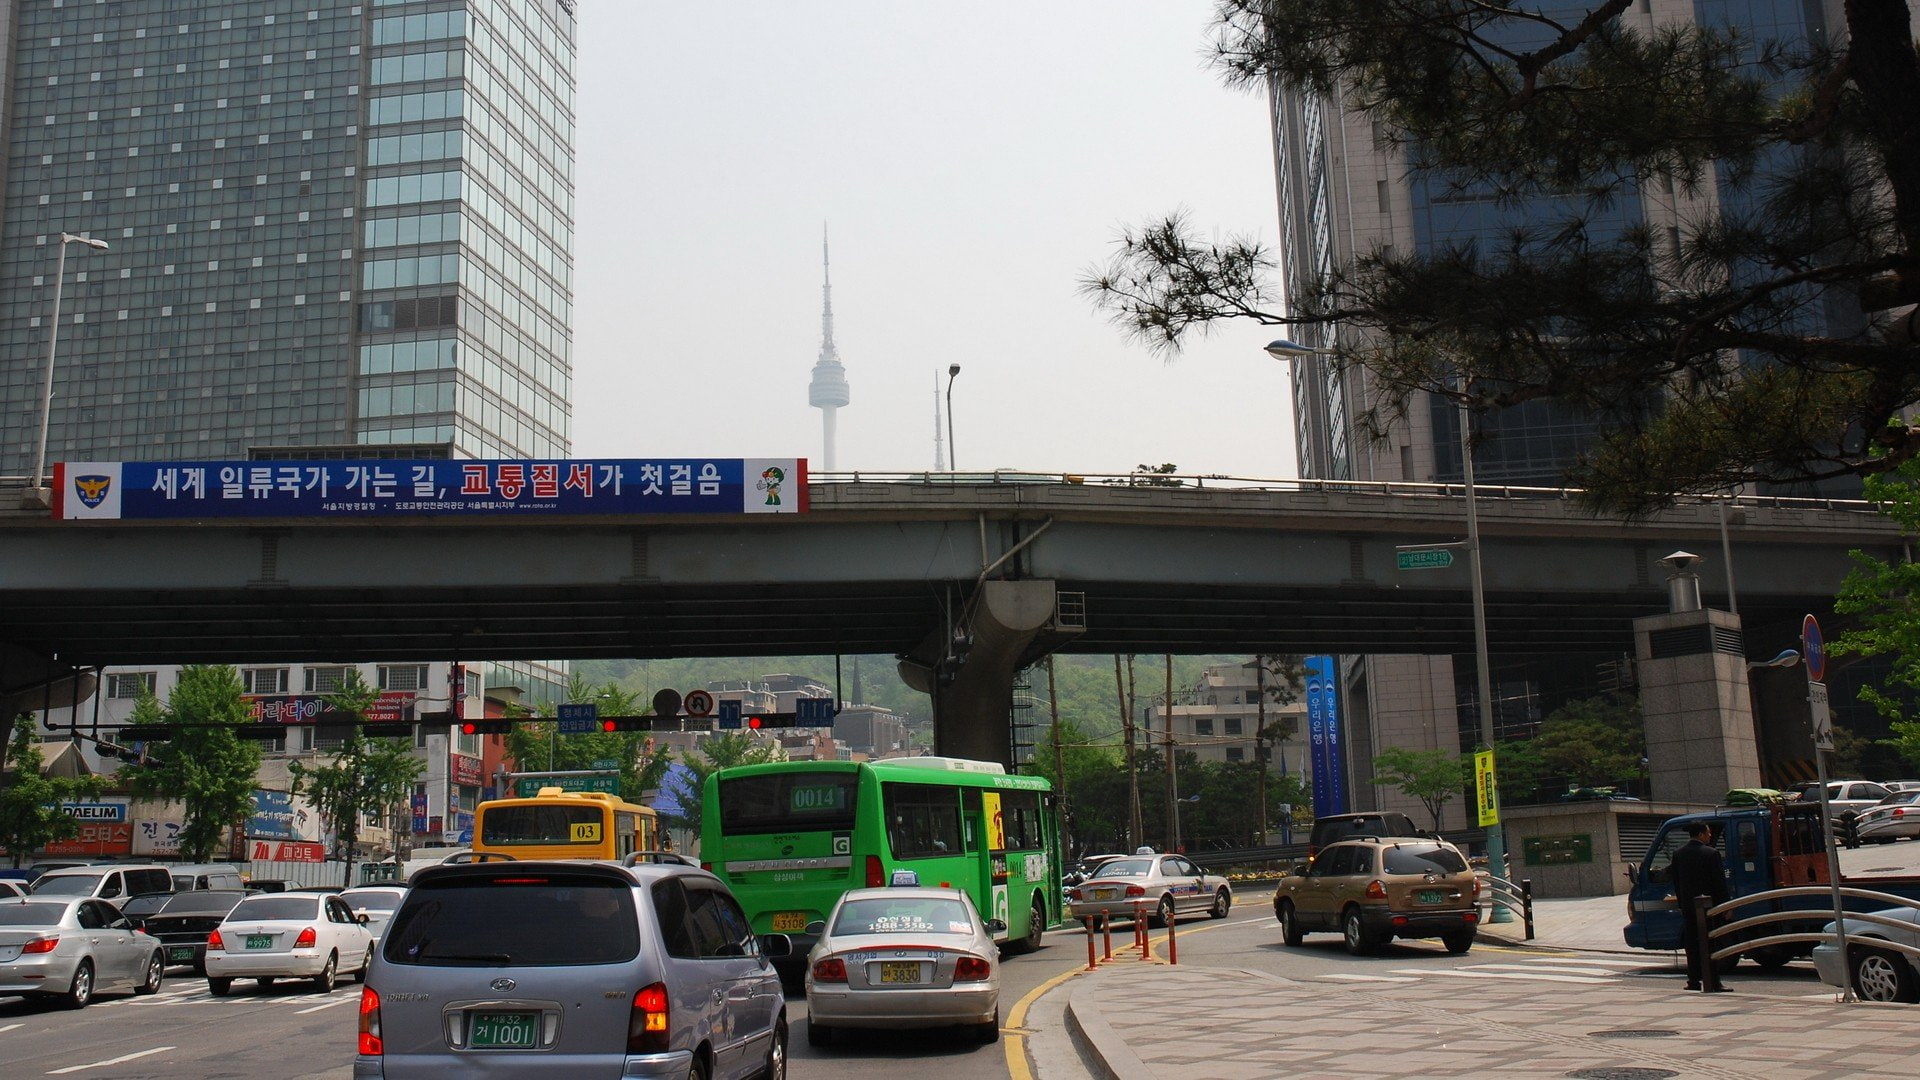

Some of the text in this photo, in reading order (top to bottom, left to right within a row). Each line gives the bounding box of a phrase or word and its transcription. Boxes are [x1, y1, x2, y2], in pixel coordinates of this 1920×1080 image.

[152, 463, 722, 500] 세계 일류국가 가는 길, 교통질서가 첫걸음
[1311, 697, 1323, 746] 우리은행
[1327, 697, 1337, 745] 우리은행
[795, 788, 834, 807] 0014
[63, 807, 117, 818] DAELIM
[577, 825, 594, 839] 03
[835, 840, 848, 852] G
[491, 1015, 520, 1025] 서울32
